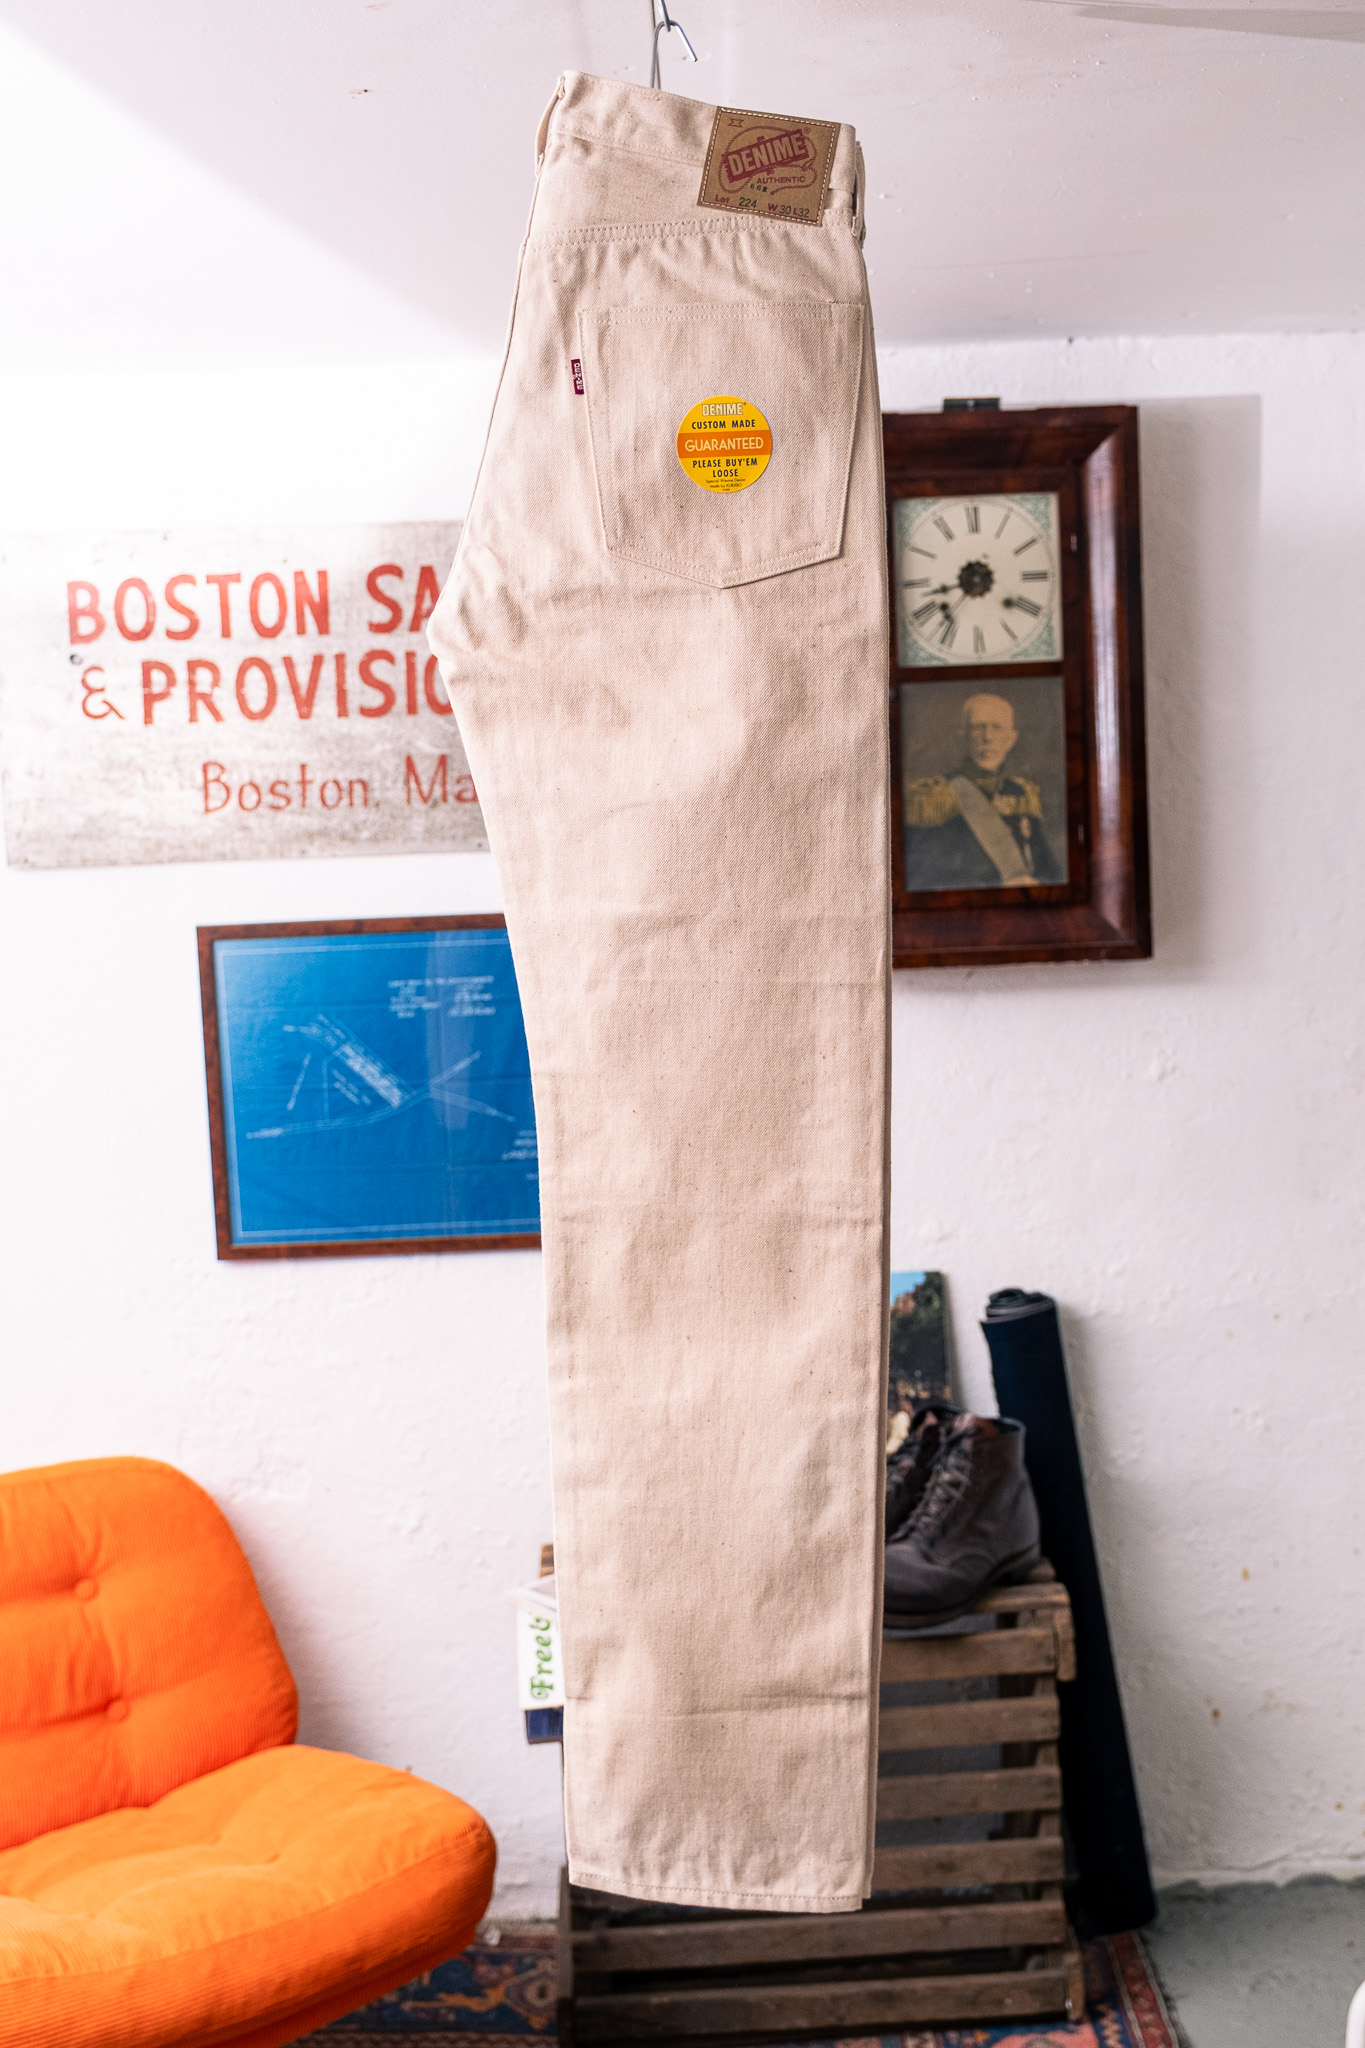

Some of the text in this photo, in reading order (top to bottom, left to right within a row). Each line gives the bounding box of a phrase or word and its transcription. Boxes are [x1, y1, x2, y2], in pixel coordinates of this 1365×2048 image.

[727, 132, 806, 177] DENIME
[757, 176, 806, 184] AUTHENTIC
[739, 197, 757, 209] 224
[702, 402, 743, 417] DENIME
[691, 419, 756, 430] CUSTOM MADE
[684, 436, 764, 452] GUARANTEED
[692, 459, 722, 469] PLEASE
[712, 468, 739, 478] LOOSE
[67, 569, 330, 645] BOSTON
[81, 665, 126, 720] &
